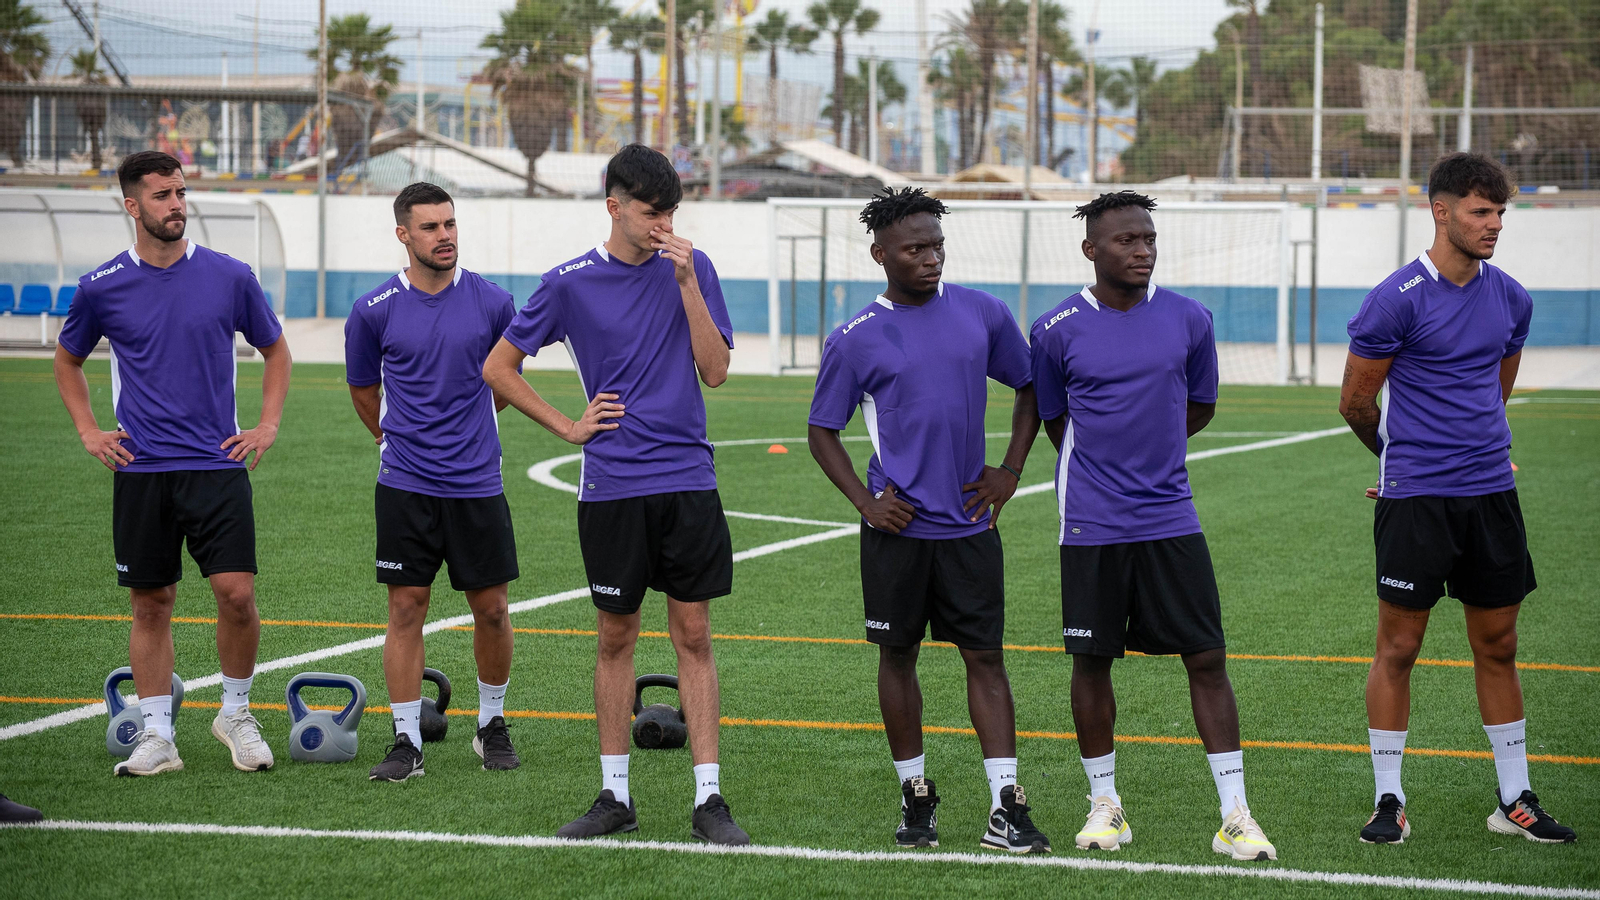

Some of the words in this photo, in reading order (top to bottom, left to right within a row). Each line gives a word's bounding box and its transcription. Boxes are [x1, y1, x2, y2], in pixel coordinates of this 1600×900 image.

[91, 263, 125, 281] LEGEA
[559, 259, 595, 275] LEGEA
[367, 287, 400, 307] LEGEA
[842, 311, 876, 335] LEGEA
[1044, 306, 1080, 331] LEGEA
[592, 583, 621, 596] LEGEA
[1380, 575, 1414, 591] LEGEA
[1063, 627, 1092, 638] LEGEA
[1507, 738, 1525, 746] LEG
[1219, 768, 1243, 777] LEGE
